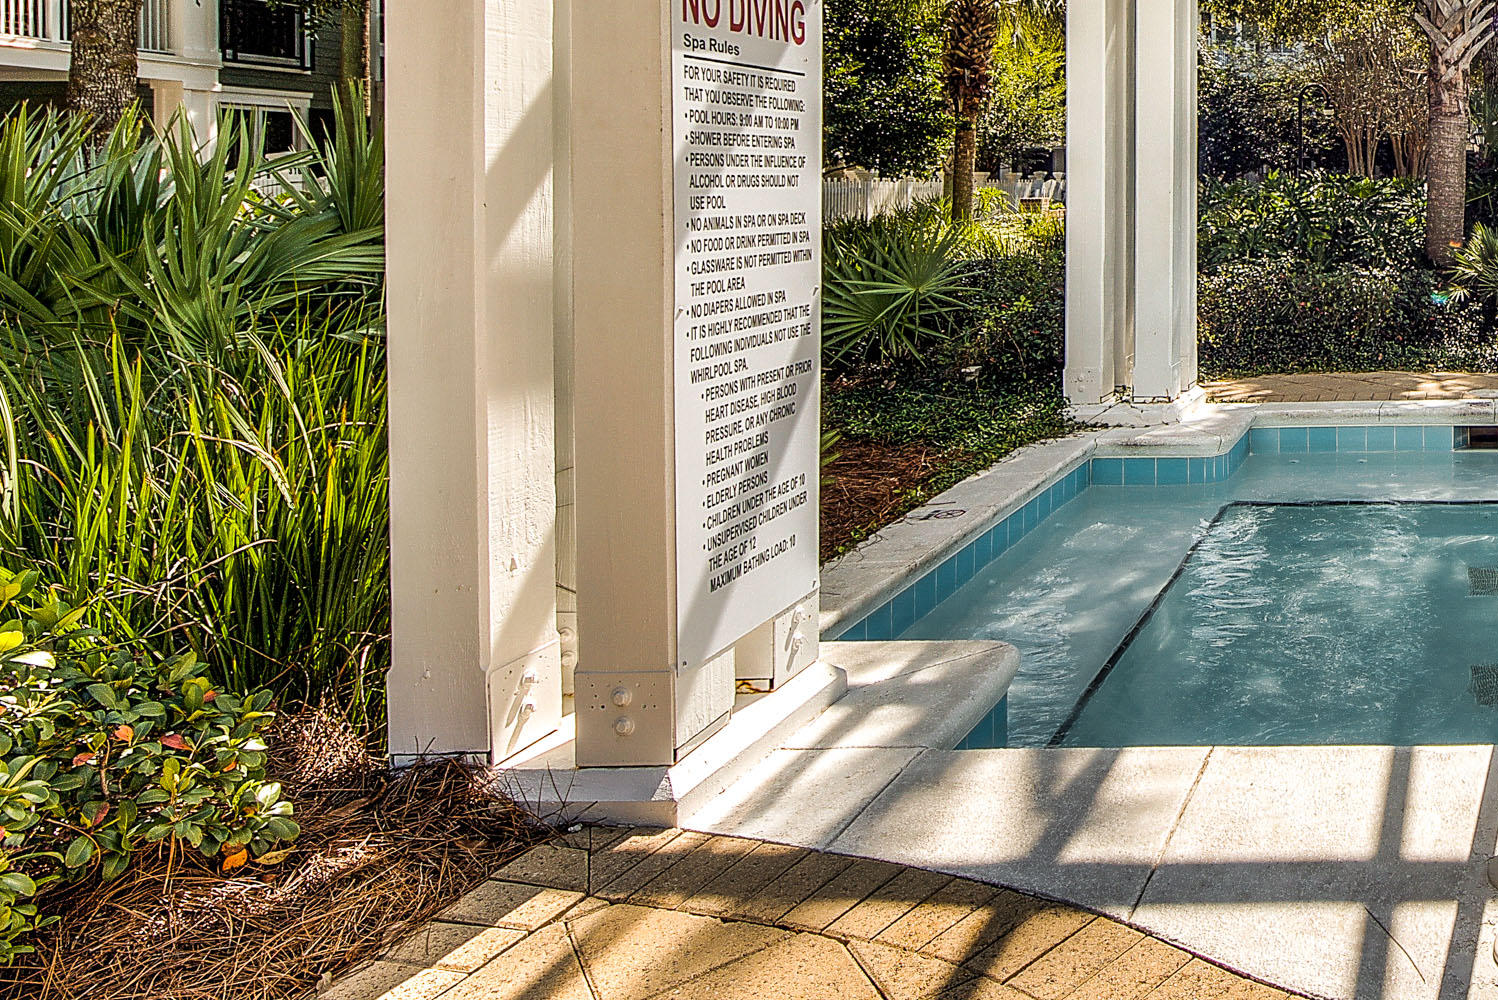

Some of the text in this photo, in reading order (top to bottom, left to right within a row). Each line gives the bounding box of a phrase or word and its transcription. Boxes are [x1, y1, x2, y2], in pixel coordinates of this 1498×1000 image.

[684, 34, 740, 55] Spa Rules
[684, 65, 795, 92] FOR YOUR SAFETY IT IS REQUIRED
[684, 87, 805, 112] THAT YOU OBSERVE THE FOLLOWING:
[690, 110, 799, 130] POOL HOURS: 9:00 AM TO 10:00 PM
[690, 131, 795, 149] SHOWER BEFORE ENTERING SPA
[690, 153, 806, 168] PERSONS UNDER THE INFLUENCE OF
[690, 175, 799, 188] ALCOHOL OR DRUGS SHOULD NOT
[690, 196, 726, 210] USE POOL
[691, 212, 806, 231] NO ANIMALS IN SPA OR ON SPA DECK
[691, 231, 810, 253] NO FOOD OR DRINK PERMITTED IN SPA
[691, 249, 812, 275] GLASSWARE IS NOT PERMITTED WITHIN
[691, 277, 745, 297] THE POOL AREA
[691, 290, 786, 318] NO DIAPERS ALLOWED IN SPA
[691, 304, 810, 340] IT IS HIGHLY RECOMMENDED THAT THE
[691, 323, 811, 362] FOLLOWING INDIVIDUALS NOT USE THE
[691, 358, 748, 384] WHIRLPOOL SPA.
[706, 360, 812, 402] PERSONS WITH PRESENT OR PRIOR
[705, 383, 796, 423] HEART DISEASE, HIGH BLOOD
[706, 402, 795, 444] PRESSURE, OR ANY CHRONIC
[706, 431, 768, 466] HEALTH PROBLEMS
[707, 451, 768, 488] PREGNANT WOMEN
[707, 471, 768, 508] ELDERLY PERSONS
[707, 473, 805, 530] CHILDREN UNDER THE AGE OF 10
[707, 491, 807, 551] UNSUPERVISED CHILDREN UNDER
[709, 536, 756, 572] THE AGE OF 12
[711, 534, 796, 592] MAXIMUM BATHING LOAD: 10
